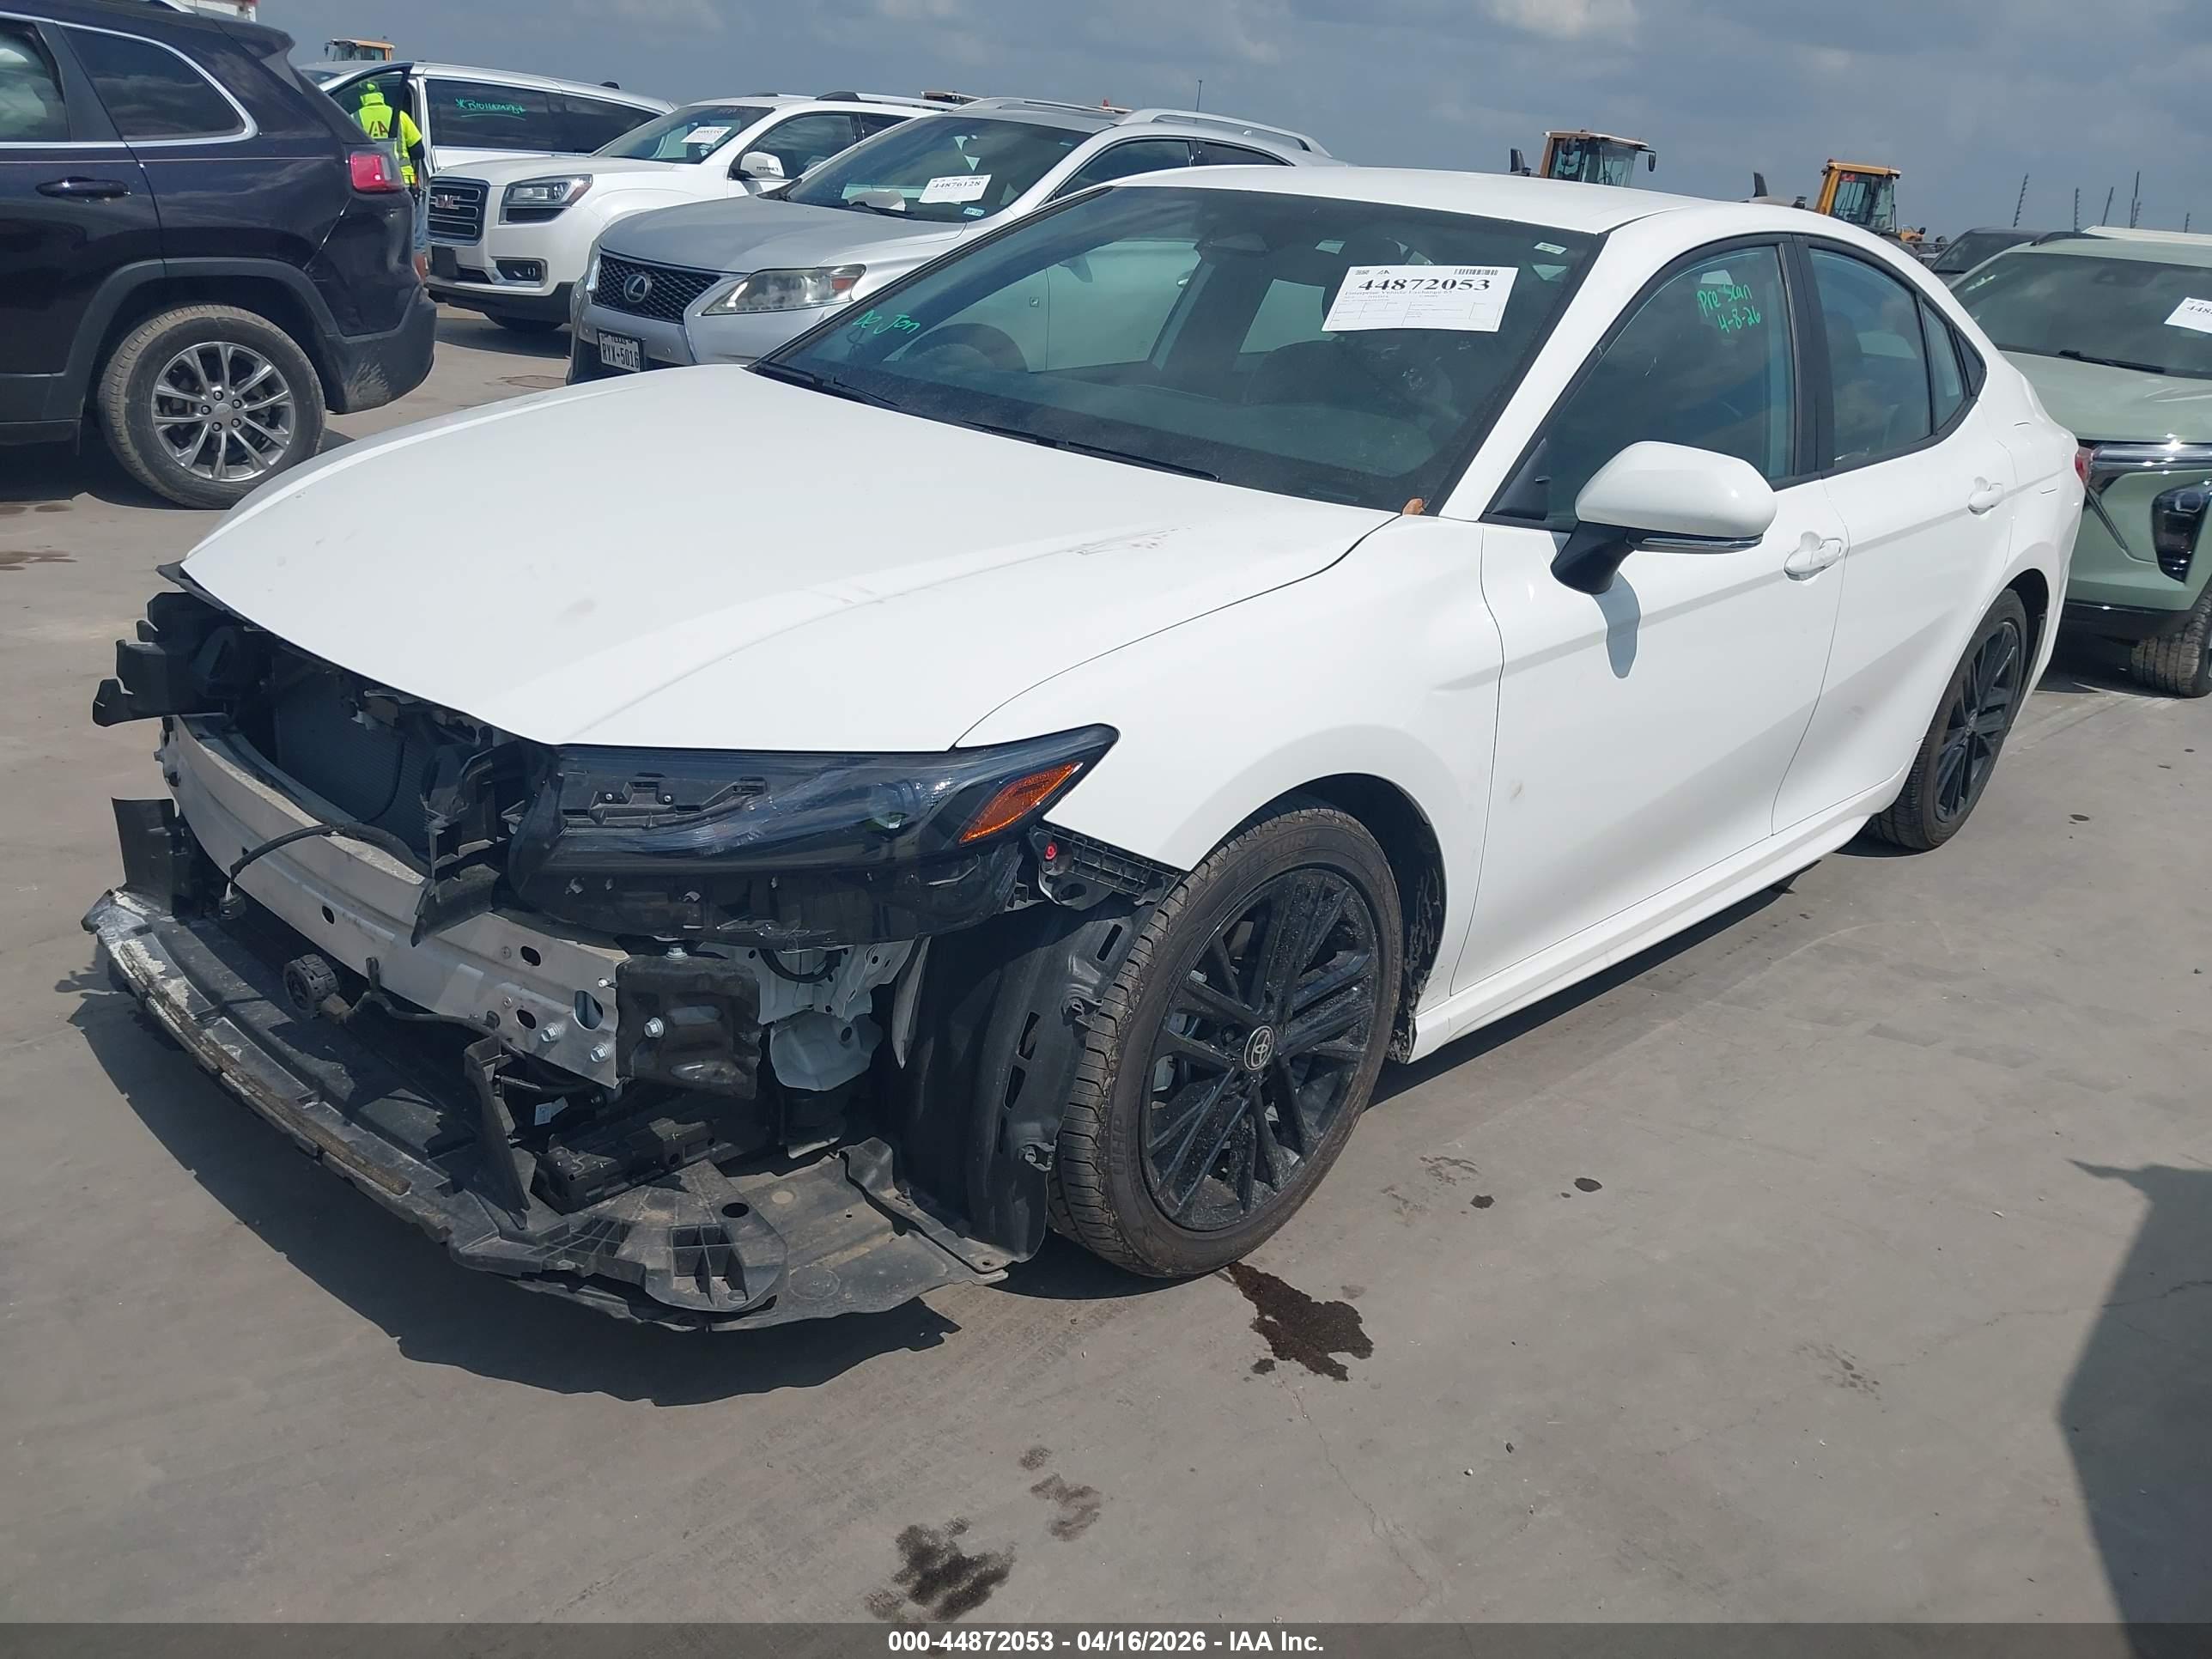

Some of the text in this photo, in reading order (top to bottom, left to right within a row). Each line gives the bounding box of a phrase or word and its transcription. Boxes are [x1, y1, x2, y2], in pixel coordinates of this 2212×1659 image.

[435, 194, 459, 210] GMC
[1358, 278, 1491, 290] 44872053
[1717, 305, 1761, 333] 4-8-26
